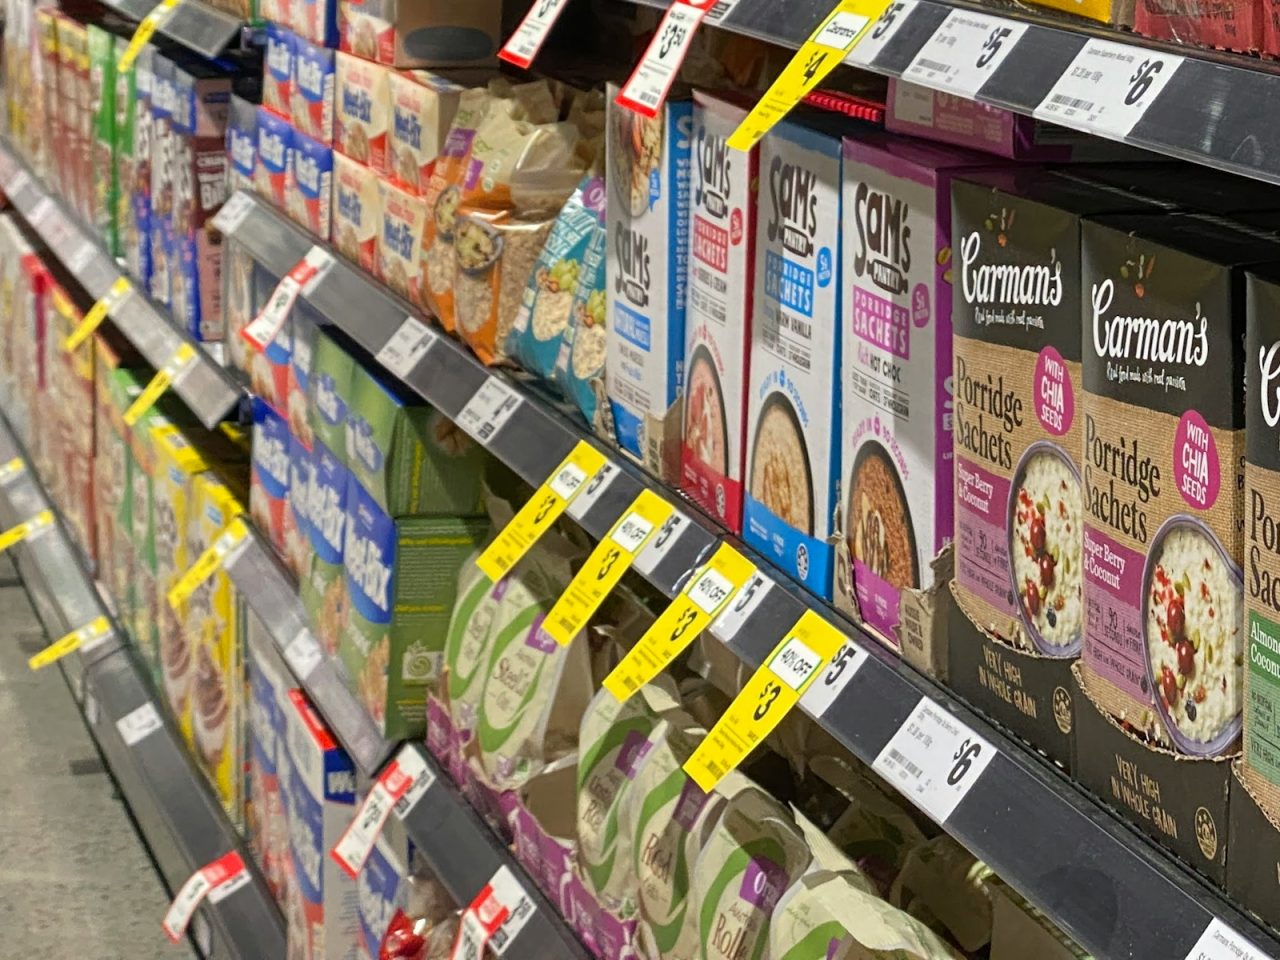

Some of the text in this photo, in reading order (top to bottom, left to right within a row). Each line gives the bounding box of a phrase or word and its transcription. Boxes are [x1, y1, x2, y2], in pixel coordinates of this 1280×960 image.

[1124, 58, 1165, 106] $6
[873, 262, 901, 291] PANTRY
[961, 231, 1062, 306] Carman's
[854, 310, 907, 355] SACHETS
[1092, 278, 1209, 367] Carman's
[883, 360, 901, 383] CHOC
[1044, 356, 1063, 381] WITH
[956, 355, 1024, 432] Porridge
[1040, 382, 1064, 412] CHIA
[956, 403, 1013, 470] Sachets
[1041, 407, 1063, 432] SEEDS
[1186, 422, 1209, 451] WITH
[1085, 413, 1161, 502] Porridge
[1182, 449, 1209, 485] CHIA
[958, 462, 994, 499] Super Berry
[1181, 476, 1207, 505] SEEDS
[1084, 464, 1148, 544] Sachets
[1084, 531, 1126, 574] Super Berry
[670, 610, 698, 641] $3
[778, 649, 813, 678] 40% OFF
[983, 647, 1004, 673] VERY
[753, 679, 782, 723] $3
[986, 668, 1012, 704] WHOLE
[1013, 690, 1038, 719] GRAIN
[947, 737, 982, 786] $6
